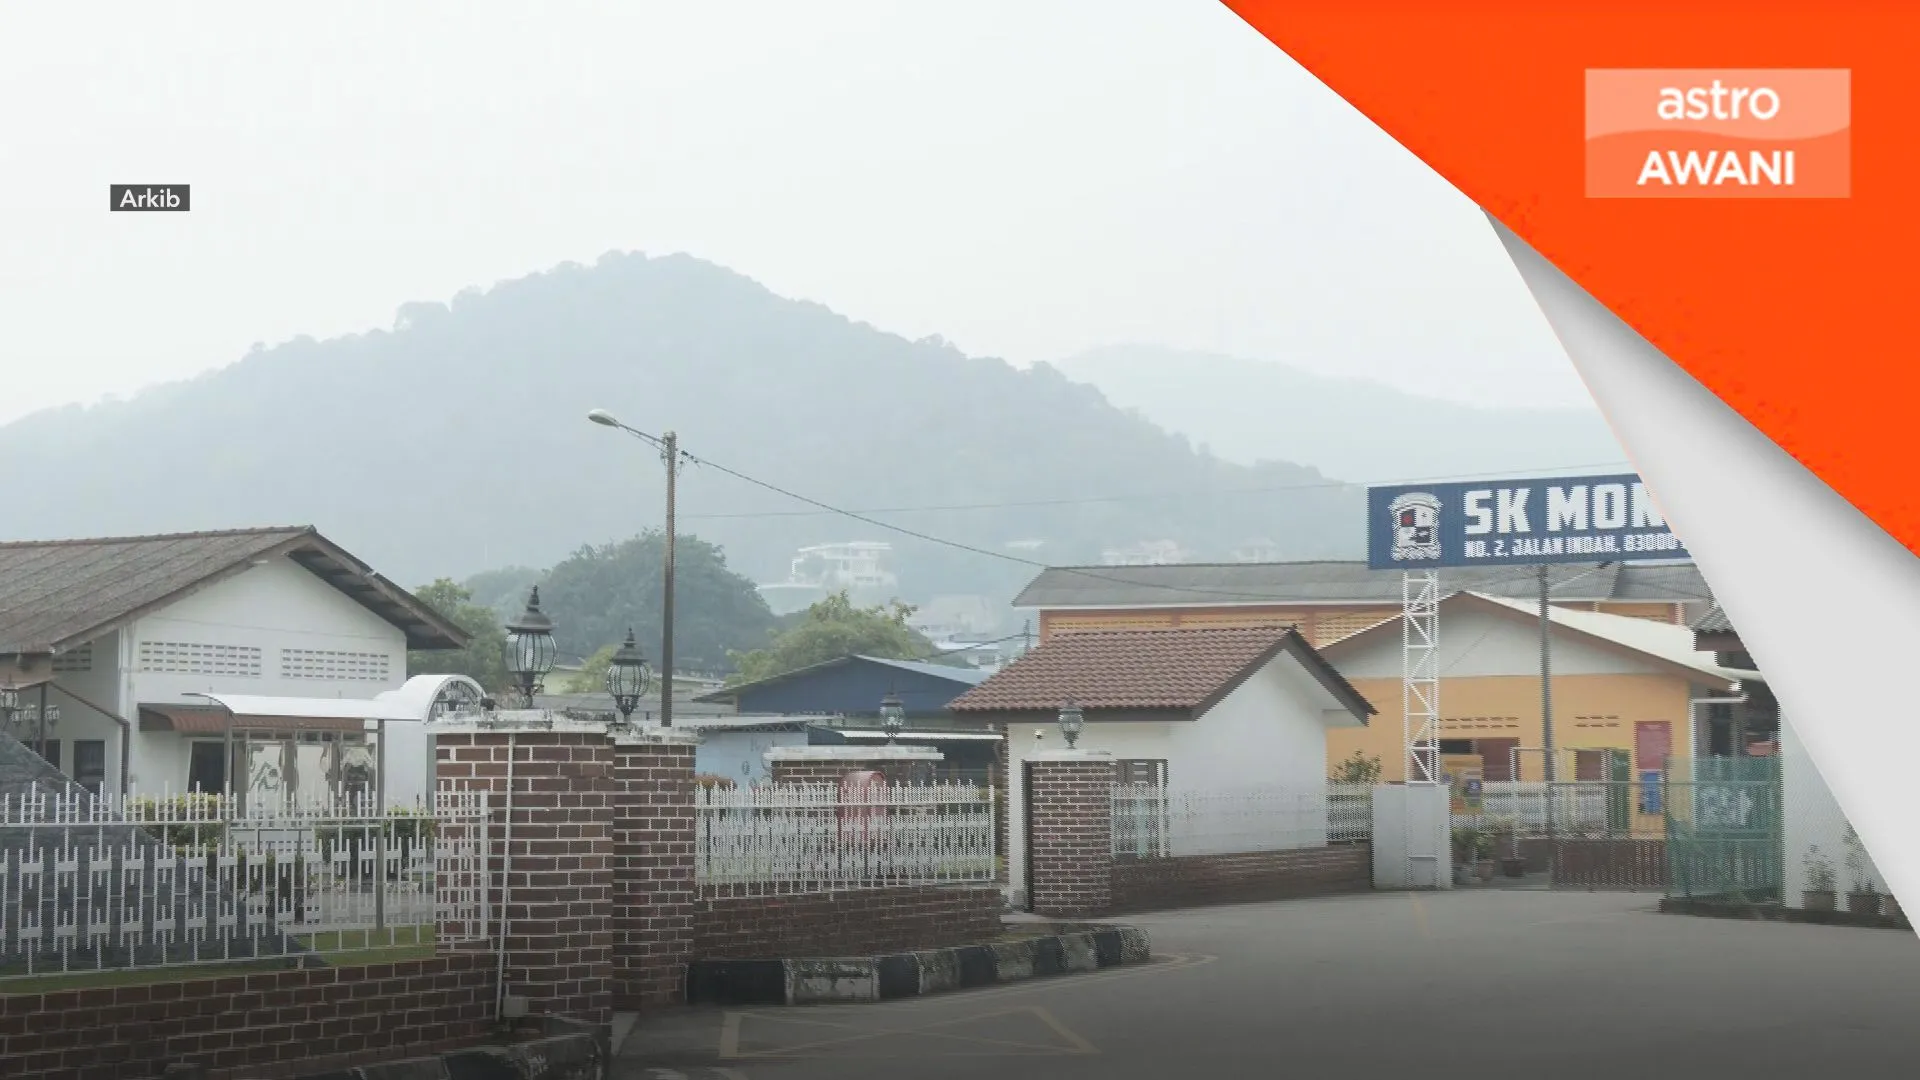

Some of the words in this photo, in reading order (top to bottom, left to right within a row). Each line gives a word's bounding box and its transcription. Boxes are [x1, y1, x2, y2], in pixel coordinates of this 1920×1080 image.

[1463, 487, 1531, 534] SK
[1464, 540, 1491, 558] NO.
[1512, 537, 1564, 557] JALAN
